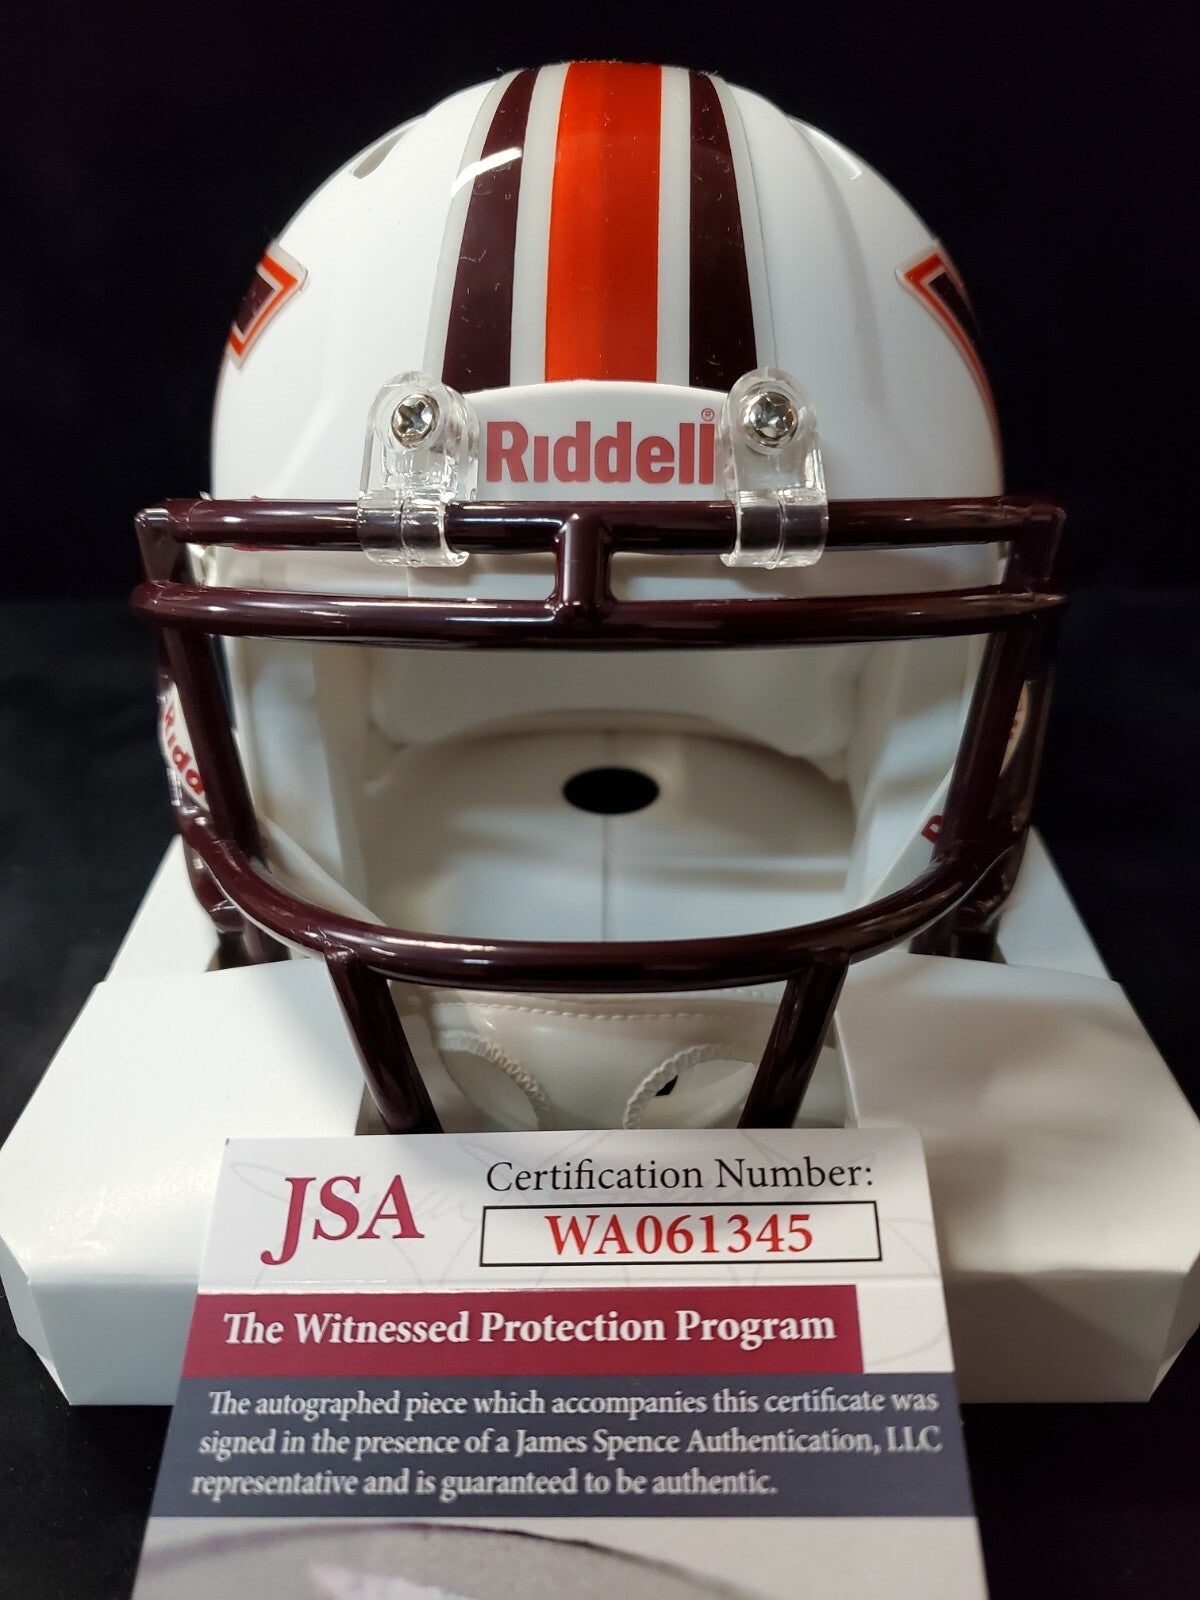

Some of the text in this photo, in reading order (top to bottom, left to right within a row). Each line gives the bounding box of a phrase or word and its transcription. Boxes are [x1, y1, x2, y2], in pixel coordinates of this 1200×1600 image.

[486, 421, 715, 484] Riddell
[486, 1156, 873, 1192] Certification Number:
[260, 1174, 425, 1266] JSA
[544, 1213, 814, 1256] WA061345
[223, 1309, 837, 1351] The Witnessed Protection Program
[208, 1386, 940, 1422] The autographed piece which accompanies this certificate was
[199, 1425, 942, 1463] signed in the presence of a James Spence Authentication, LLC
[191, 1467, 778, 1503] representative and is guaranteed to be authentic.
